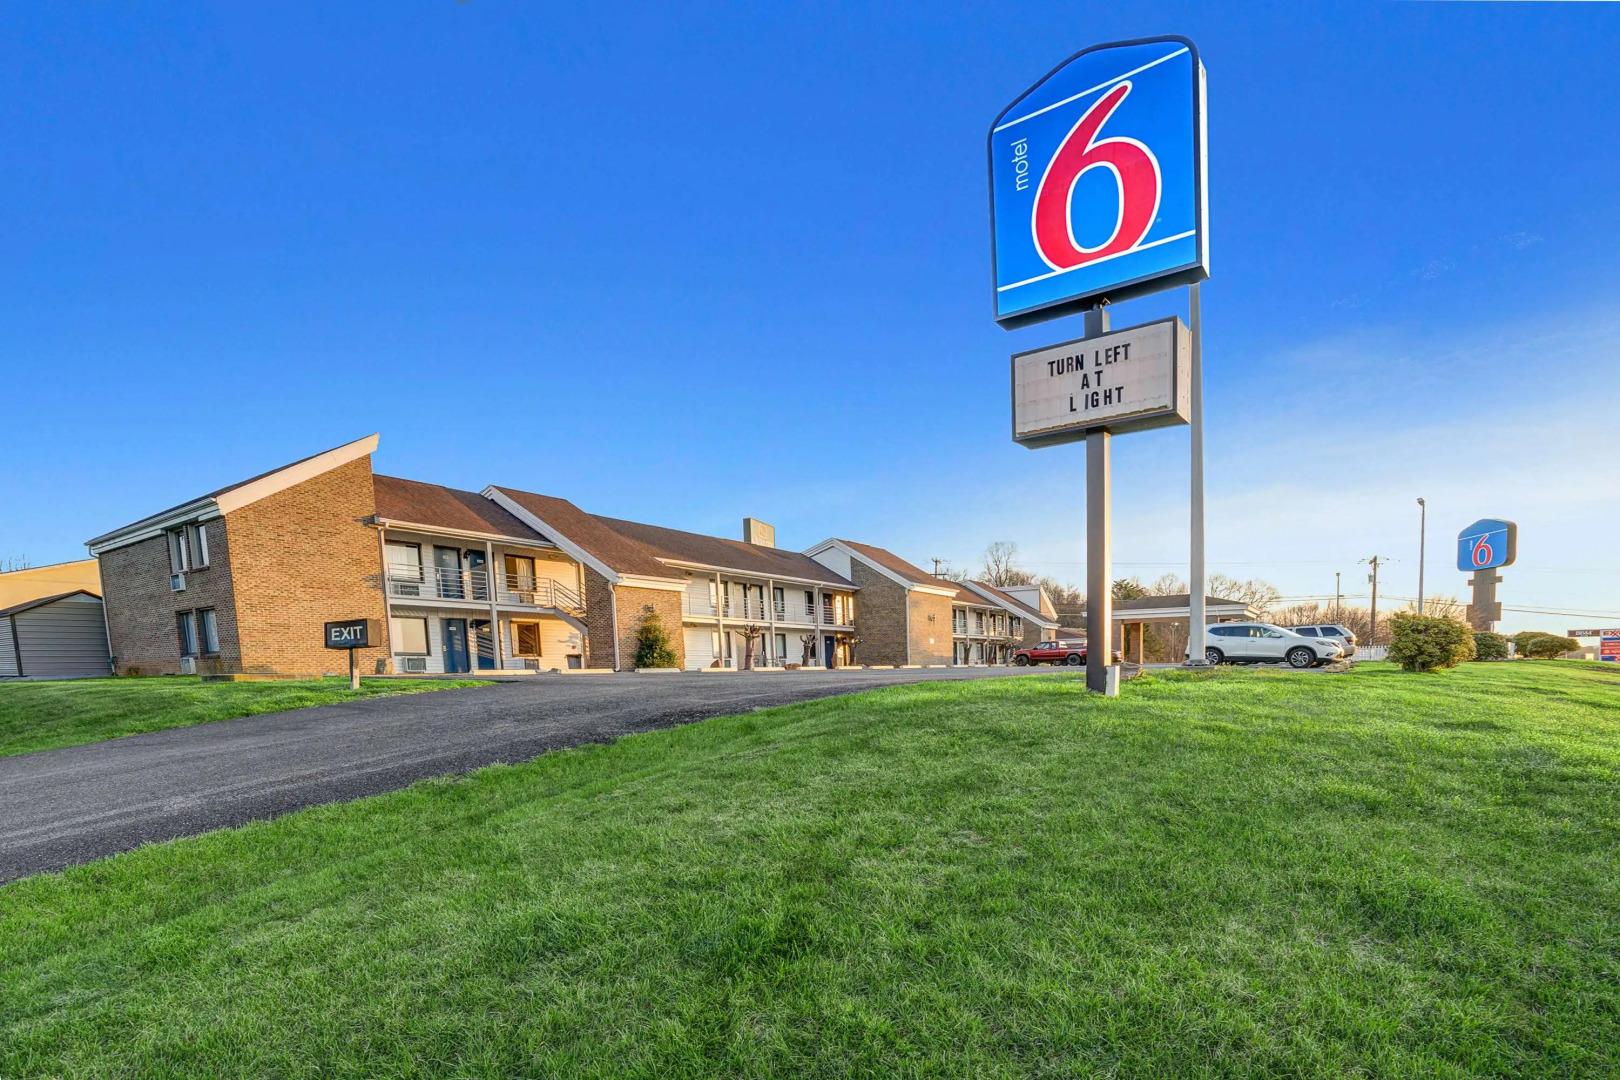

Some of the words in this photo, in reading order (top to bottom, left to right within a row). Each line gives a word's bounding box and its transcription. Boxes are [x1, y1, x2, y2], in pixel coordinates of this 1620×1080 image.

[1011, 138, 1029, 192] motel
[1031, 79, 1162, 273] 6
[1048, 353, 1084, 377] TURN
[1095, 343, 1131, 367] LEFT
[1081, 370, 1103, 390] AT
[1472, 533, 1493, 567] 6
[331, 626, 363, 641] EXIT
